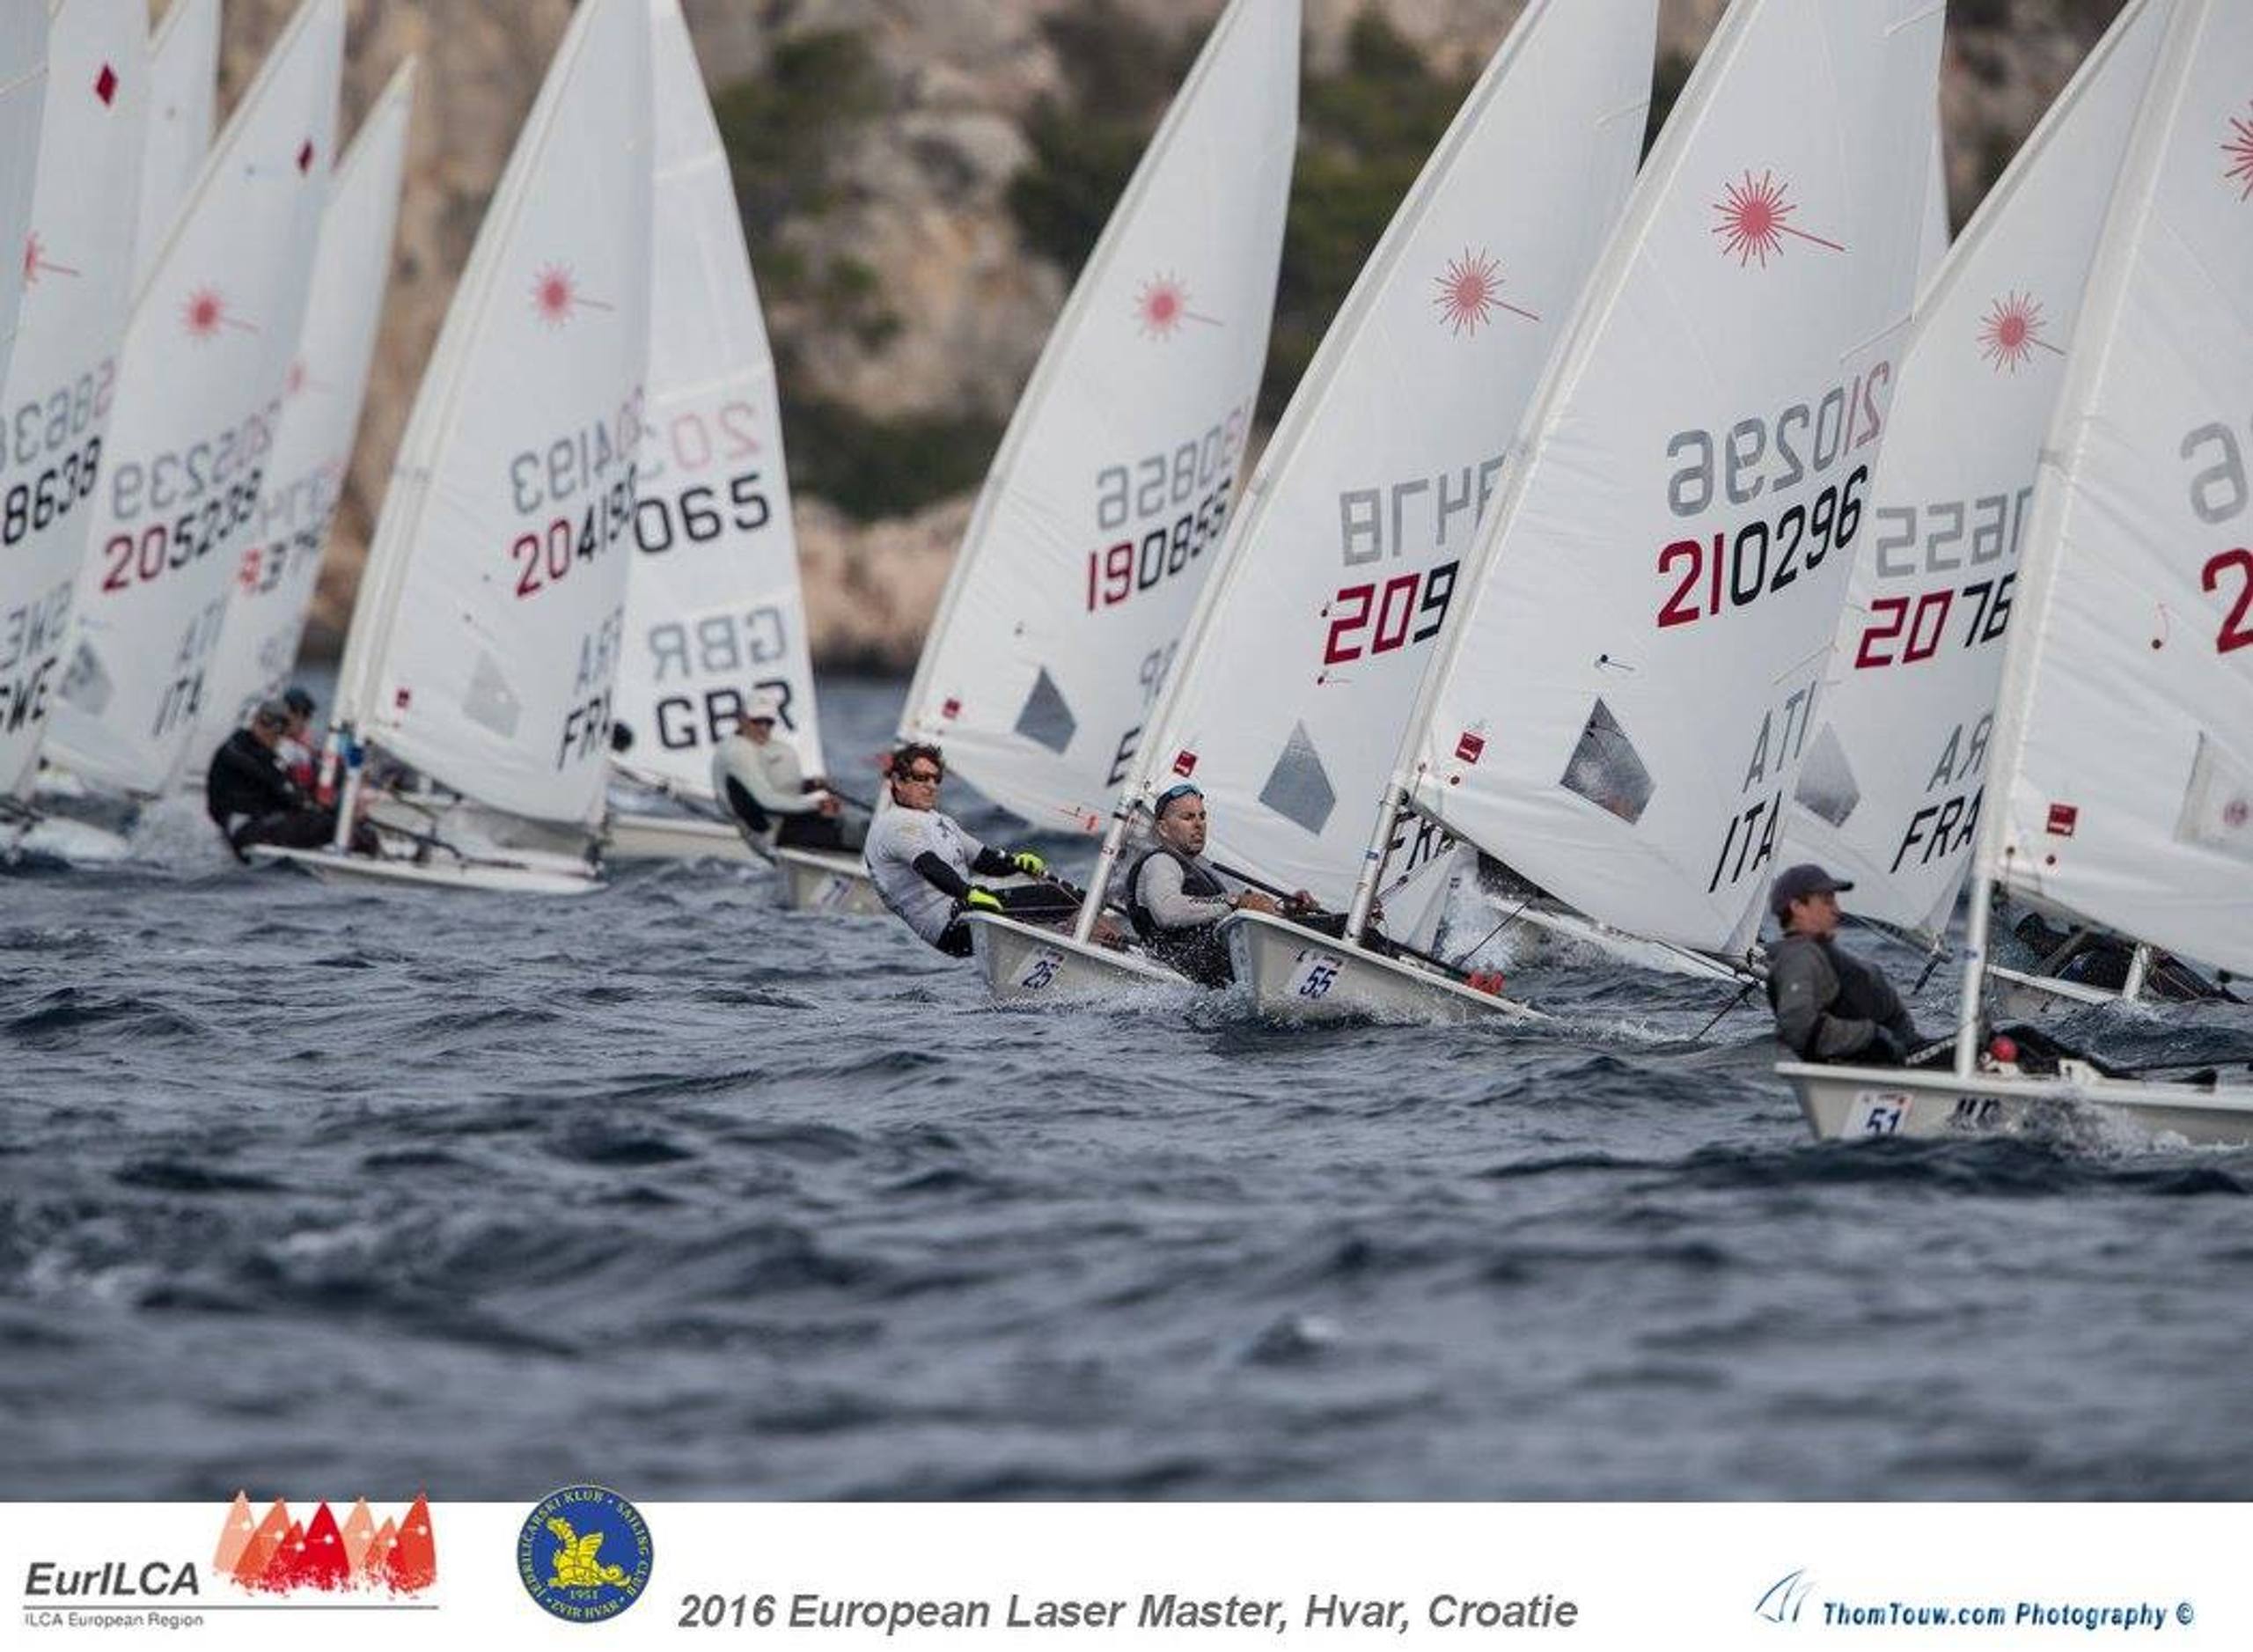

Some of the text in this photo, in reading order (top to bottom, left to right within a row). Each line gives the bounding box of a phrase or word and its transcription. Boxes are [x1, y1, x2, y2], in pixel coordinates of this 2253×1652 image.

[1658, 465, 1868, 628] 210296
[1325, 561, 1460, 664] 209
[1855, 572, 2016, 668] 2076
[1708, 790, 1782, 892] ITA
[1890, 784, 1985, 873] FRA
[1299, 966, 1338, 999] 55
[1866, 1108, 1902, 1134] 51
